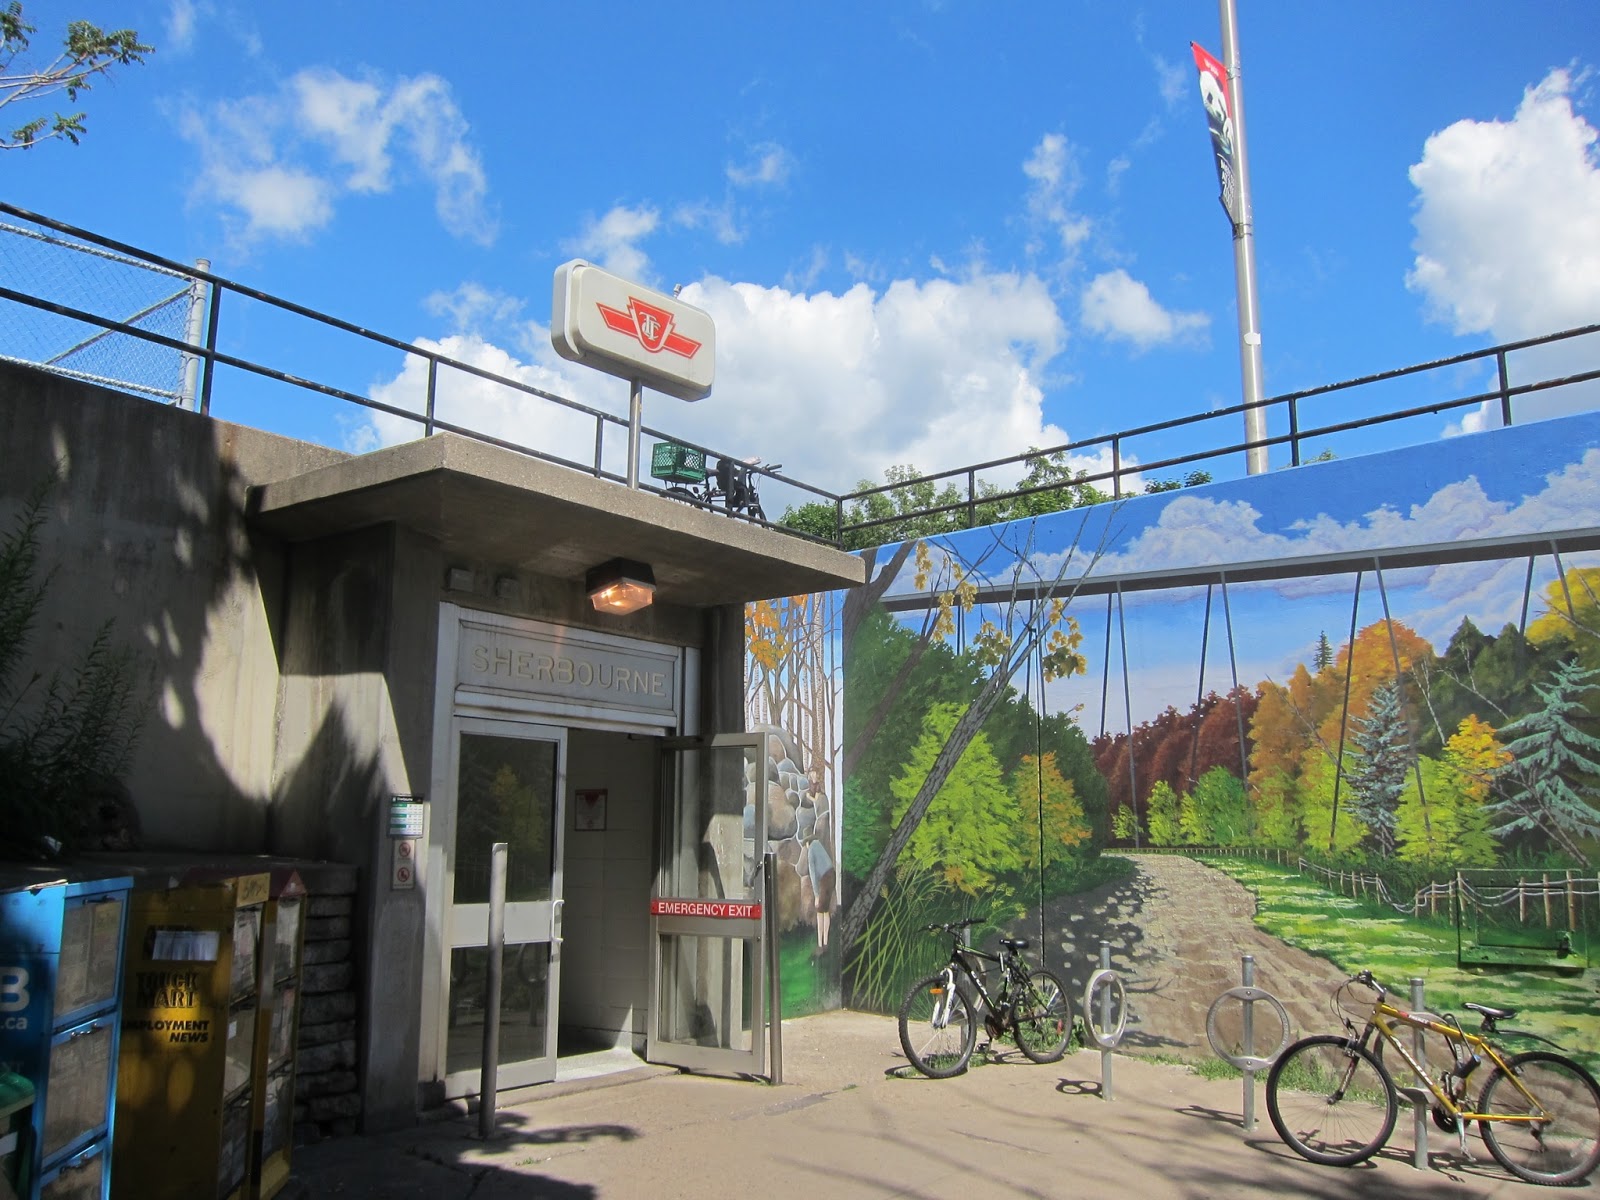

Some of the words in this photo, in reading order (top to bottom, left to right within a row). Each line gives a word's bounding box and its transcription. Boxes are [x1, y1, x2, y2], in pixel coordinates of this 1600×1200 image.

[472, 645, 666, 697] SHERBOURNE
[658, 902, 726, 916] EMERGENCY
[728, 904, 753, 917] EXIT
[170, 1032, 208, 1043] NEWS
